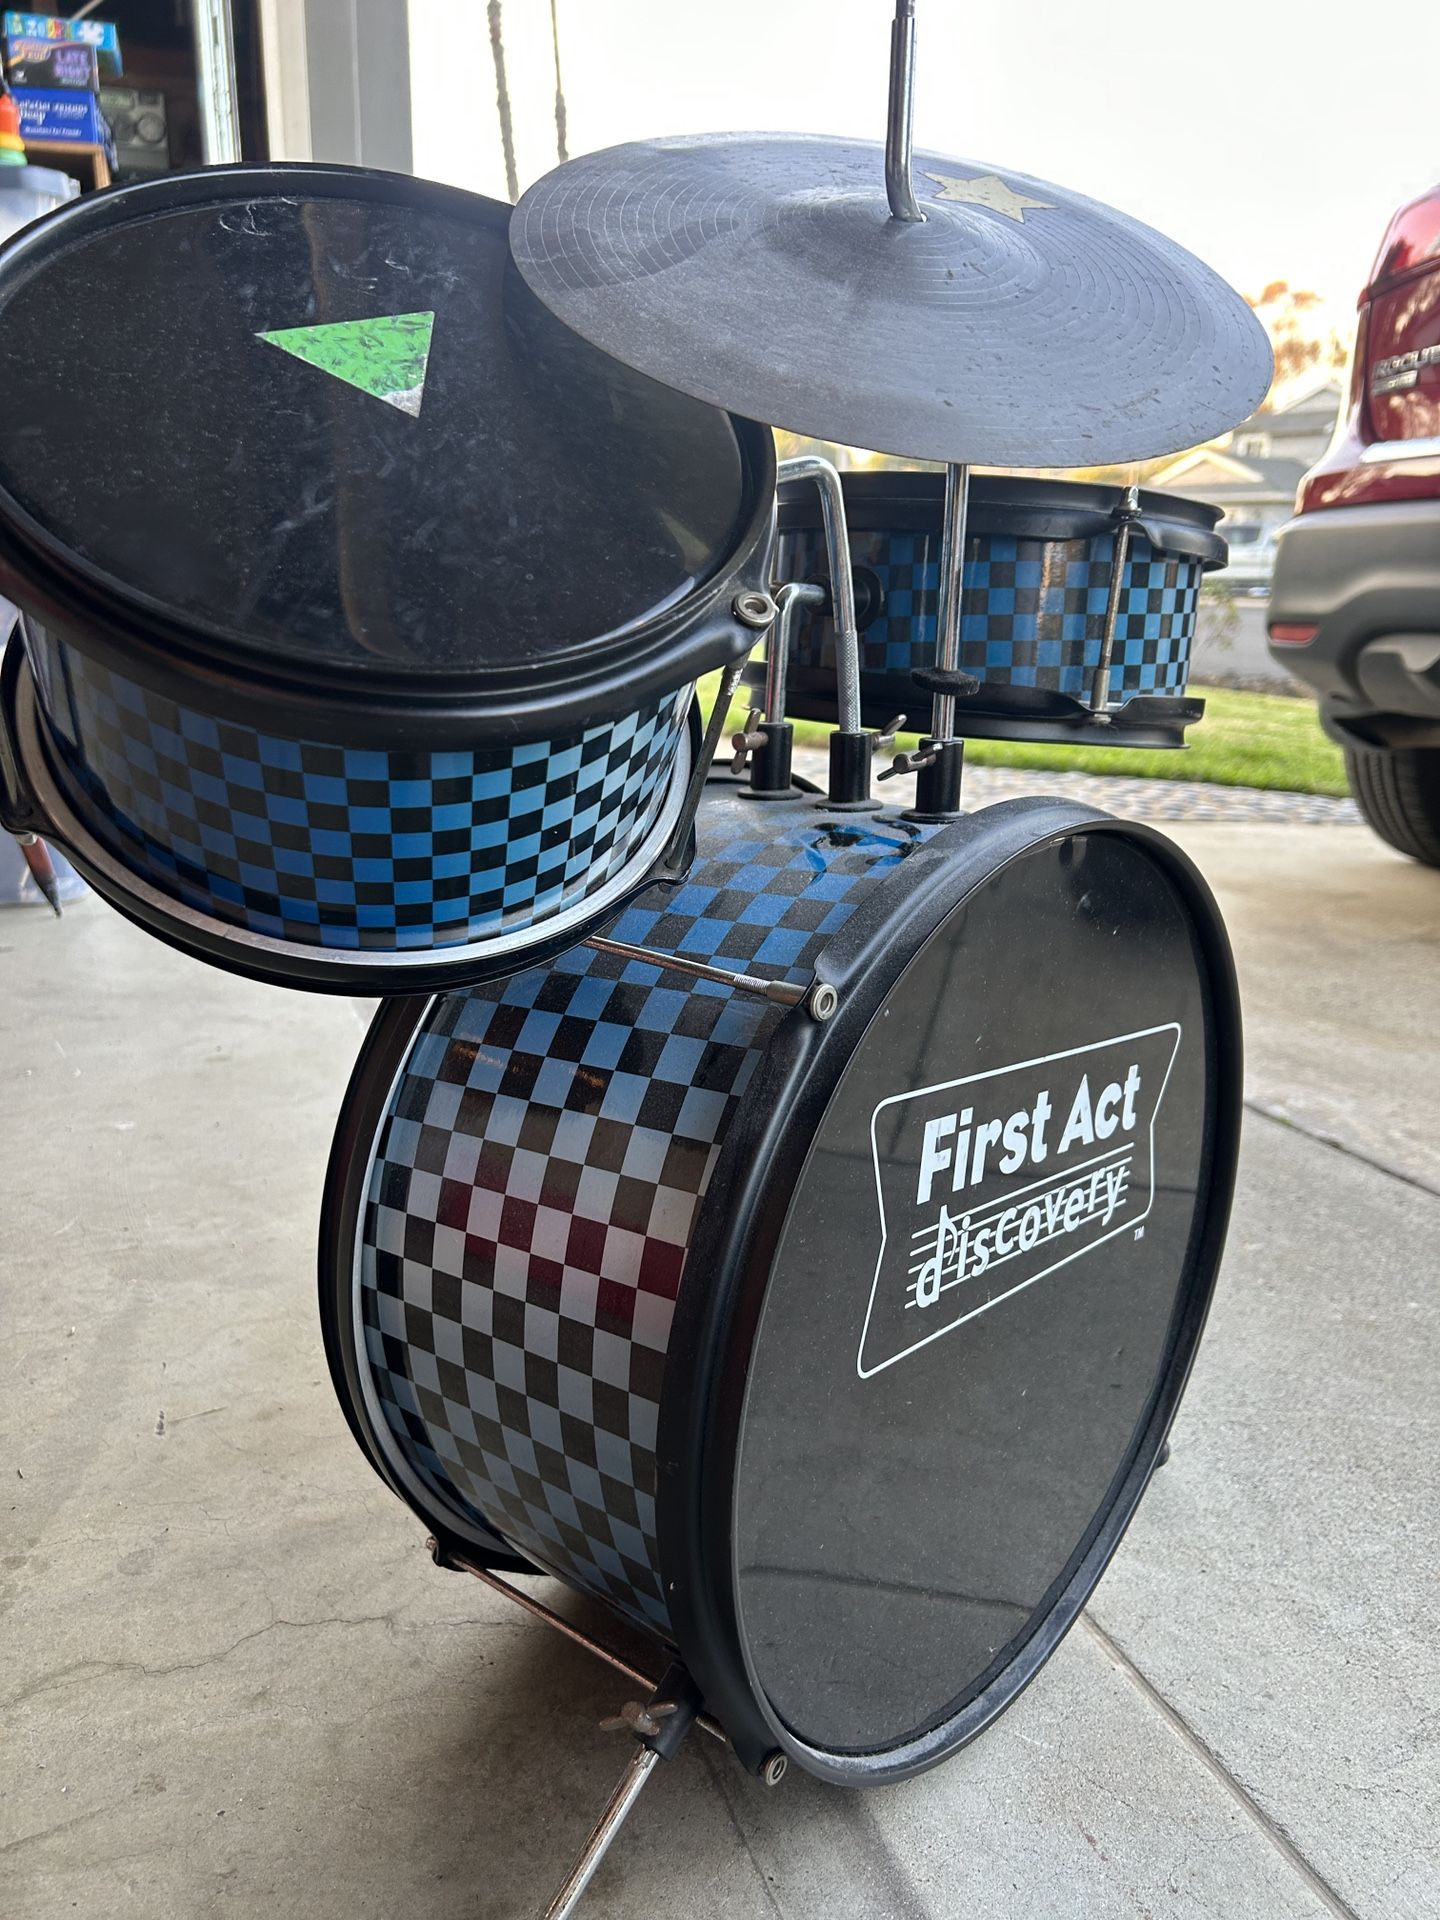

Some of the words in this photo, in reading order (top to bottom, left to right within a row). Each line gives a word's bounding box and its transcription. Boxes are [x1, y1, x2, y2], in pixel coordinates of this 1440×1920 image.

[916, 1090, 1052, 1205] First
[1057, 1064, 1141, 1154] Act
[915, 1166, 1126, 1309] discovery
